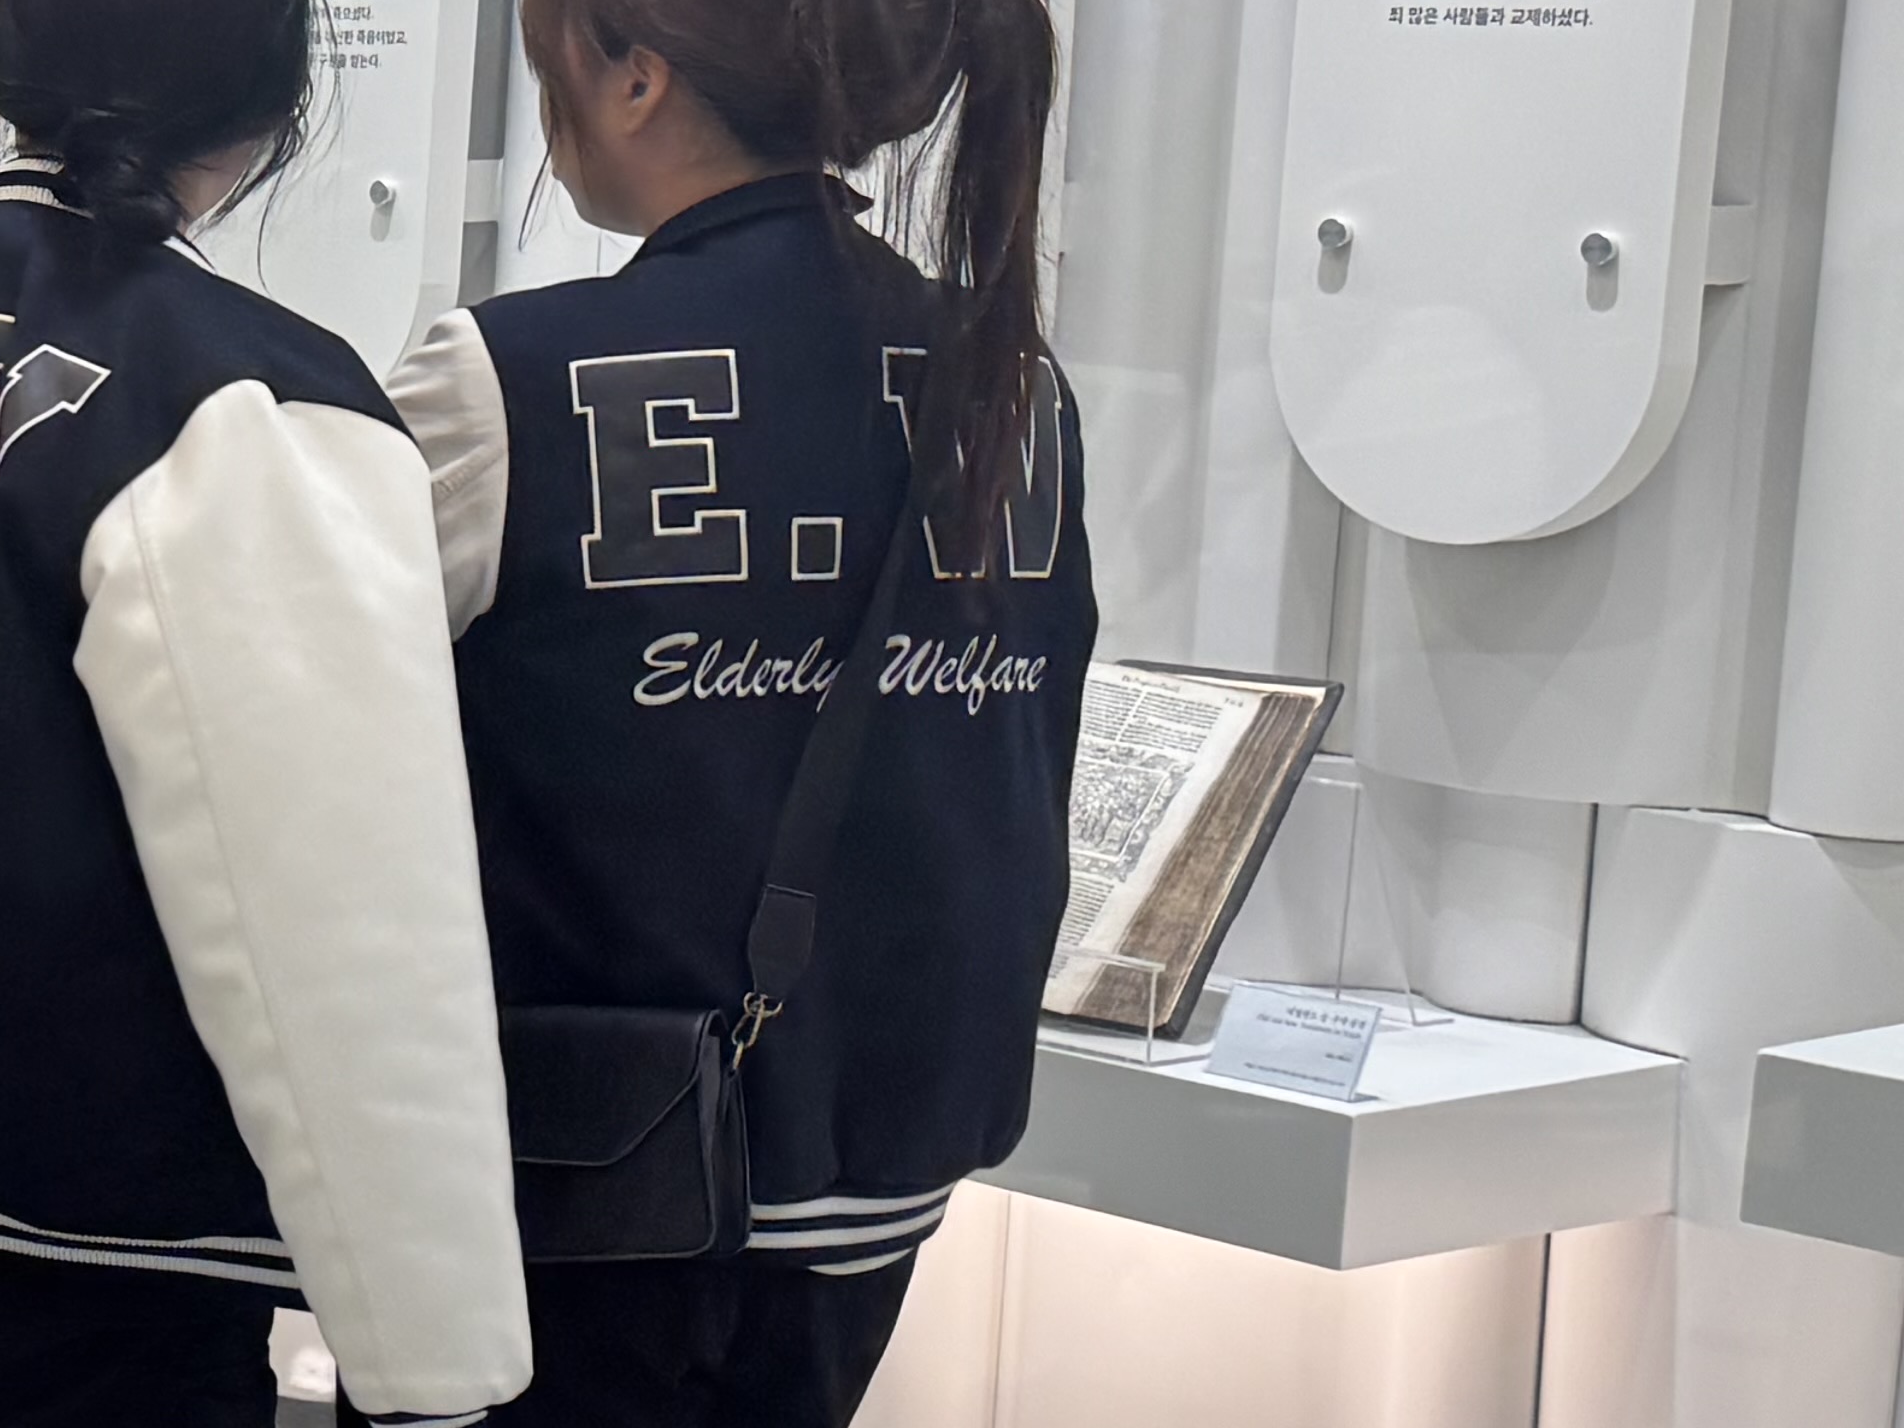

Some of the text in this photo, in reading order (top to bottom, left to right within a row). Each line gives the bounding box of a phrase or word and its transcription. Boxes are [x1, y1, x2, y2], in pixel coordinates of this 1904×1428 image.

[1443, 7, 1505, 26] 사람들과
[1510, 7, 1593, 27] 교제하셨다.
[632, 630, 1049, 717] Elderly Welfare
